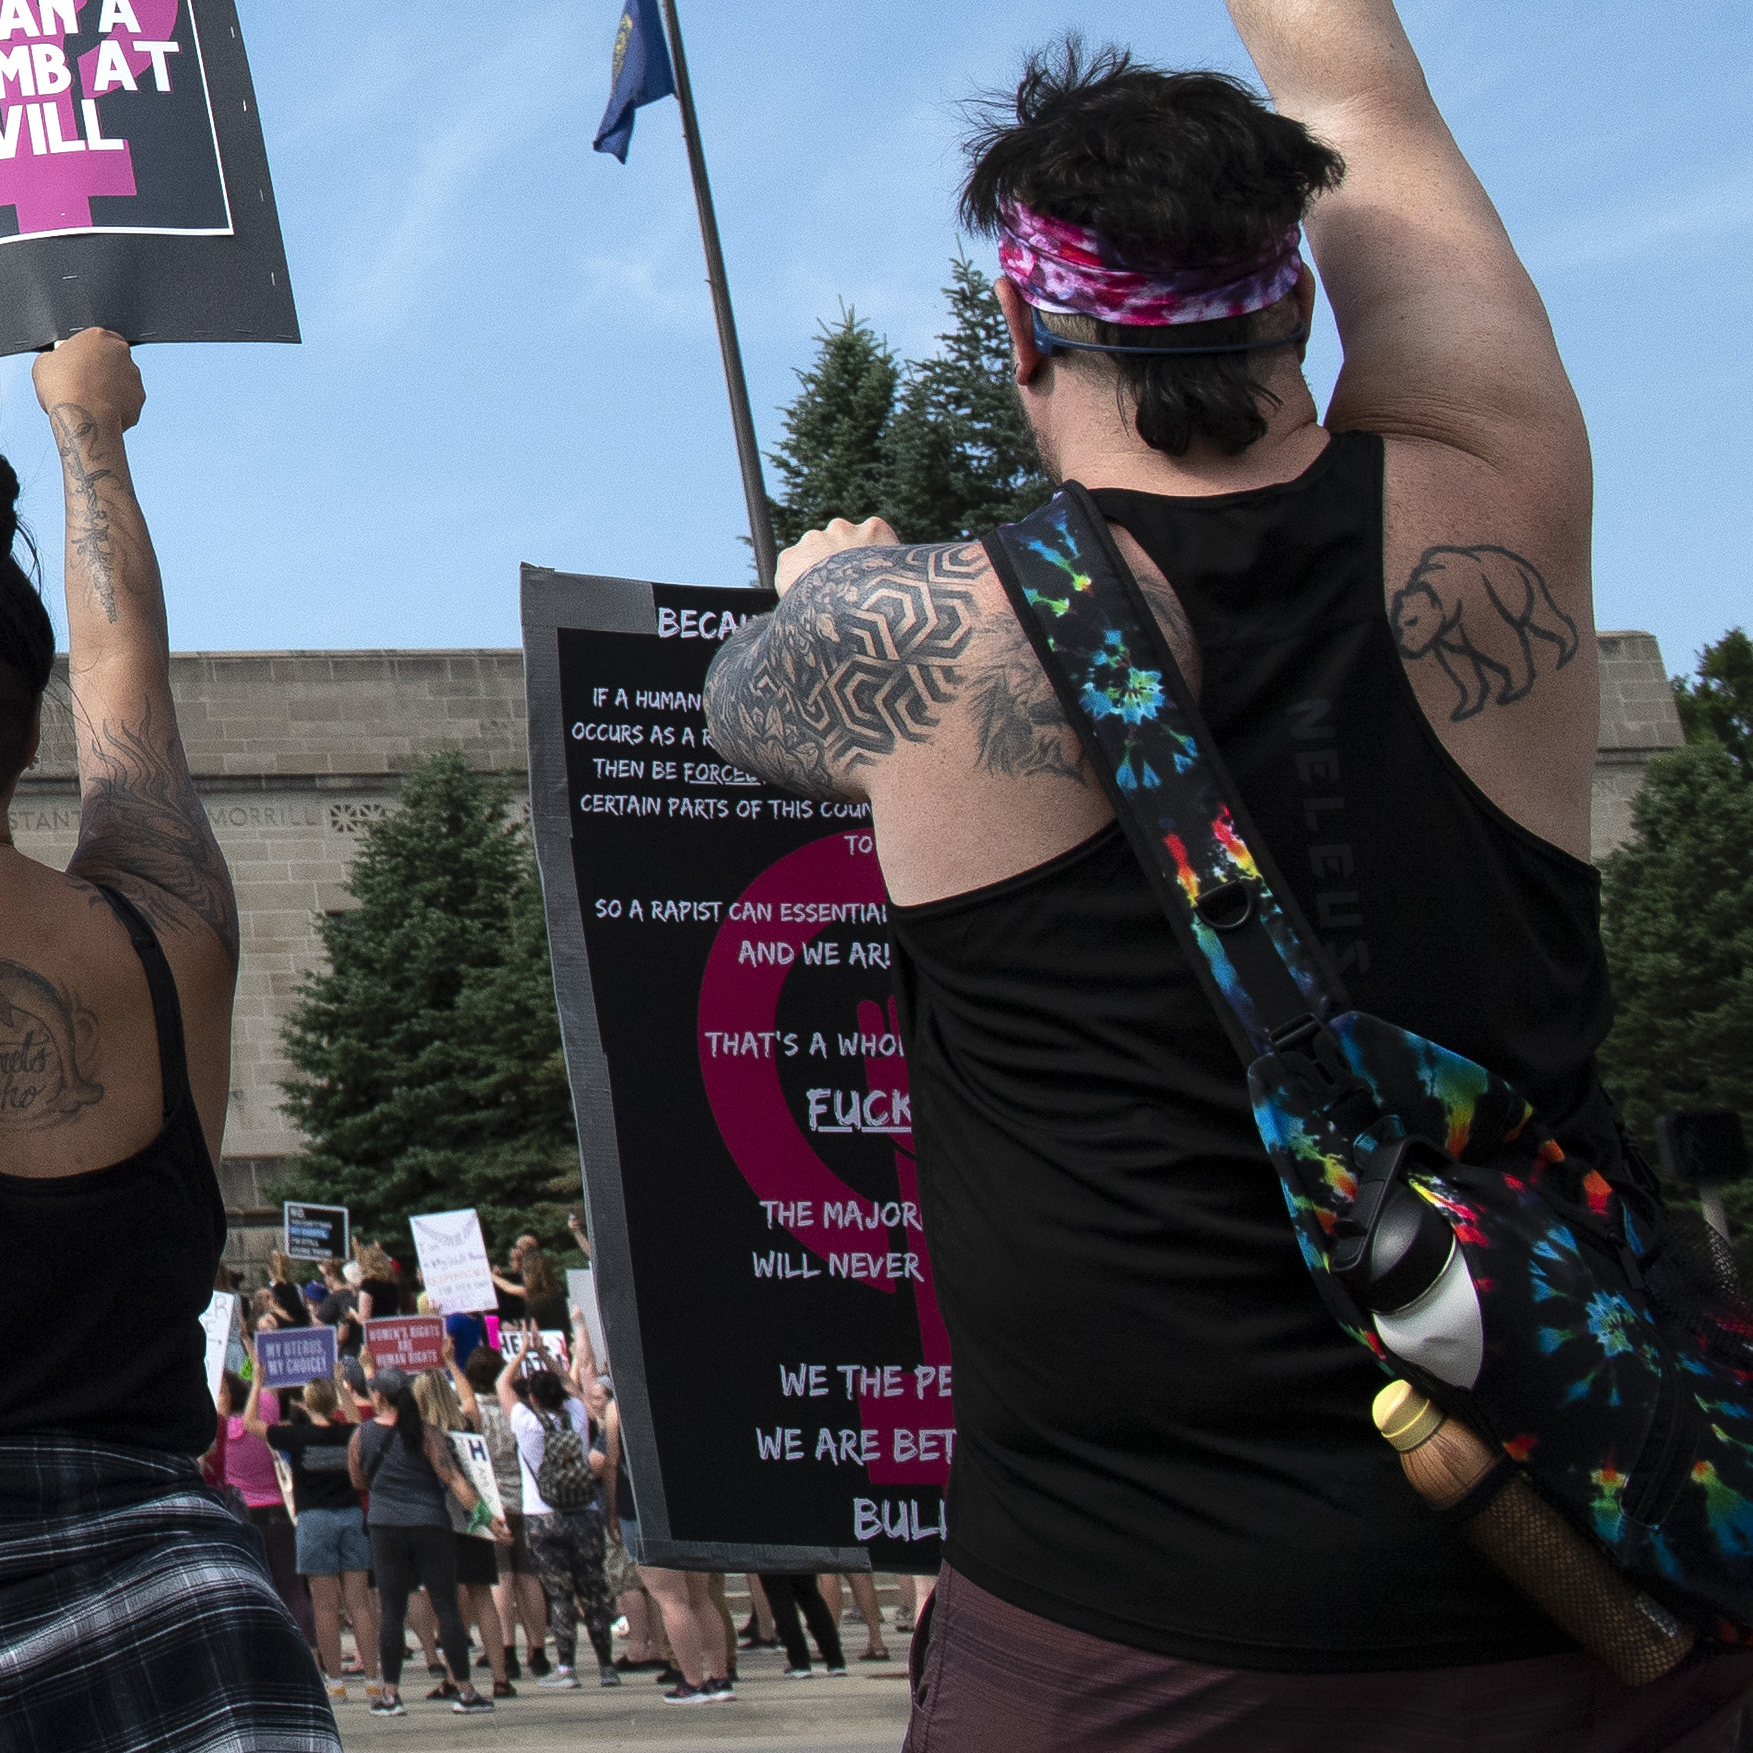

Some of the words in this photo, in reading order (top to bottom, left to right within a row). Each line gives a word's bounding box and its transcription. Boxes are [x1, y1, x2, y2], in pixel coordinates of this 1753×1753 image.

[93, 40, 181, 93] AT
[658, 607, 747, 640] BECA
[592, 688, 609, 710] IF
[615, 688, 630, 711] A
[635, 690, 702, 713] HUMAN
[571, 722, 644, 746] OCCURS
[650, 725, 675, 747] AS
[681, 727, 695, 747] A
[593, 758, 644, 781] THEN
[651, 760, 678, 781] BE
[580, 794, 662, 818] CERTAIN
[668, 797, 730, 819] PARTS
[736, 799, 763, 819] OF
[767, 800, 813, 820] THIS
[844, 834, 873, 856] TO
[595, 898, 622, 919] SO
[629, 900, 644, 922] A
[651, 900, 723, 923] RAPIST
[728, 902, 773, 924] CAN
[738, 940, 796, 968] AND
[801, 942, 841, 966] WE
[704, 1030, 799, 1059] THAT'S
[809, 1034, 828, 1059] A
[759, 1200, 815, 1230] THE
[823, 1200, 924, 1232] MAJOR
[752, 1250, 822, 1280] WILL
[828, 1251, 925, 1283] NEVER
[368, 1329, 407, 1343] WOMEN'S
[409, 1325, 440, 1339] RIGHTS
[398, 1338, 414, 1350] ARE
[265, 1341, 282, 1358] MY
[375, 1352, 408, 1367] HUMAN
[409, 1350, 438, 1363] RIGHTS
[267, 1358, 285, 1376] MY
[286, 1355, 327, 1375] CHOICE!
[779, 1362, 830, 1397] WE
[836, 1364, 905, 1400] THE
[913, 1365, 952, 1400] PE
[755, 1426, 805, 1461] WE
[814, 1427, 881, 1466] ARE
[892, 1427, 957, 1466] BET
